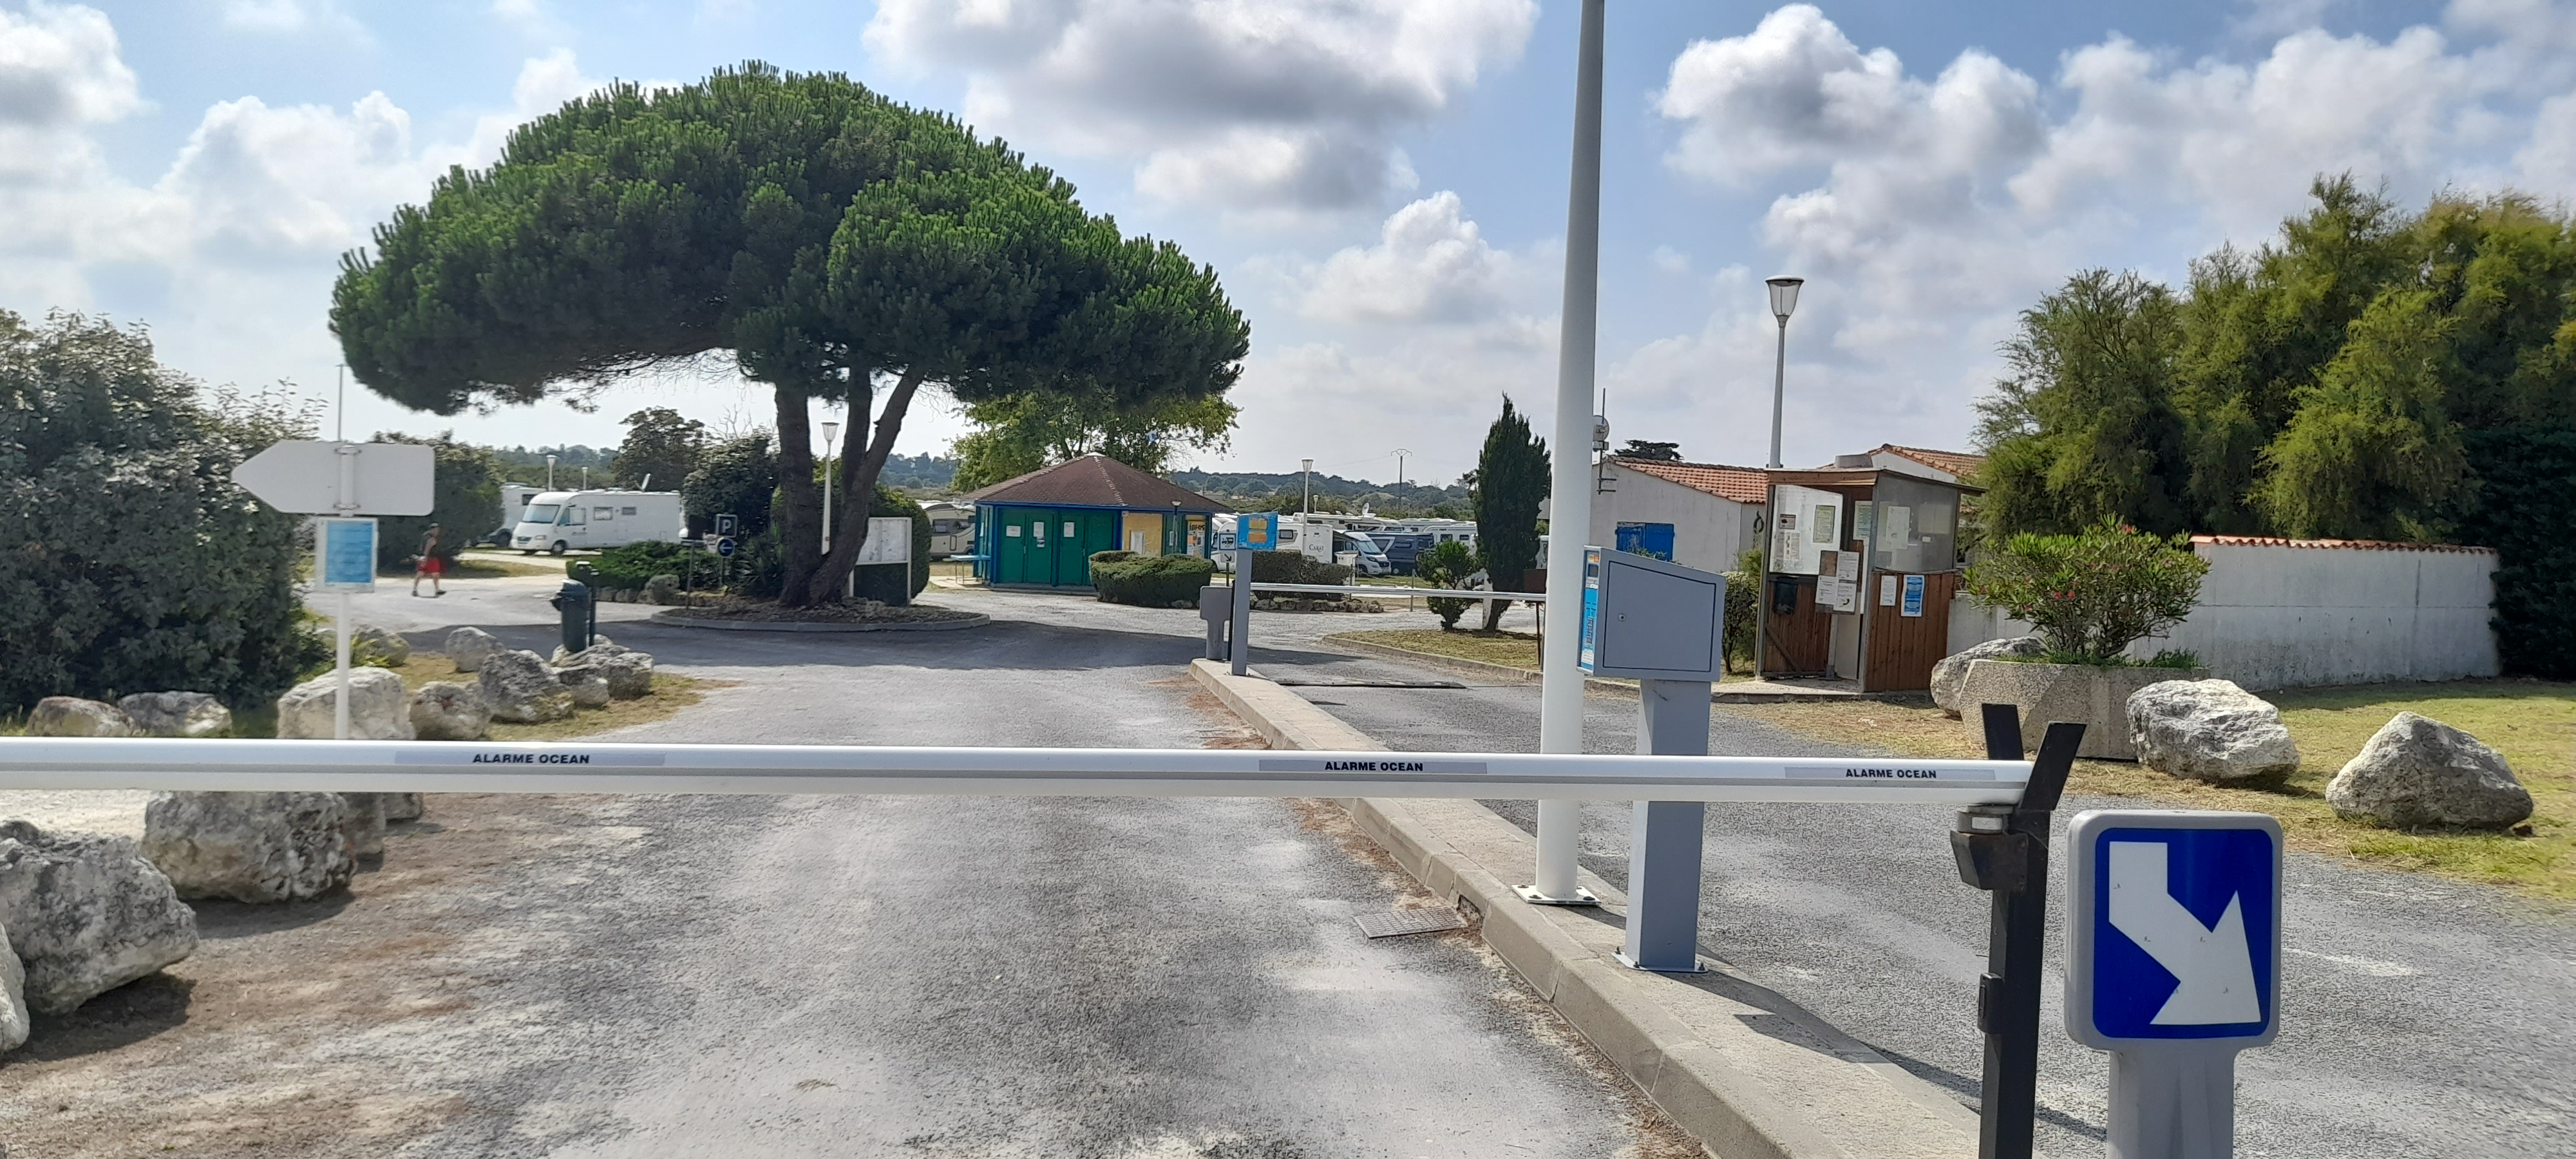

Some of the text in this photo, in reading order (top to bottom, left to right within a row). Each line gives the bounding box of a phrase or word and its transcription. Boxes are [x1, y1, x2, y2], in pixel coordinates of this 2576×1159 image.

[722, 519, 732, 533] P
[473, 753, 590, 764] ALARME OCEAN
[1324, 761, 1423, 771] ALARME OCEAN
[1846, 769, 1937, 778] ALARME OCEAN
